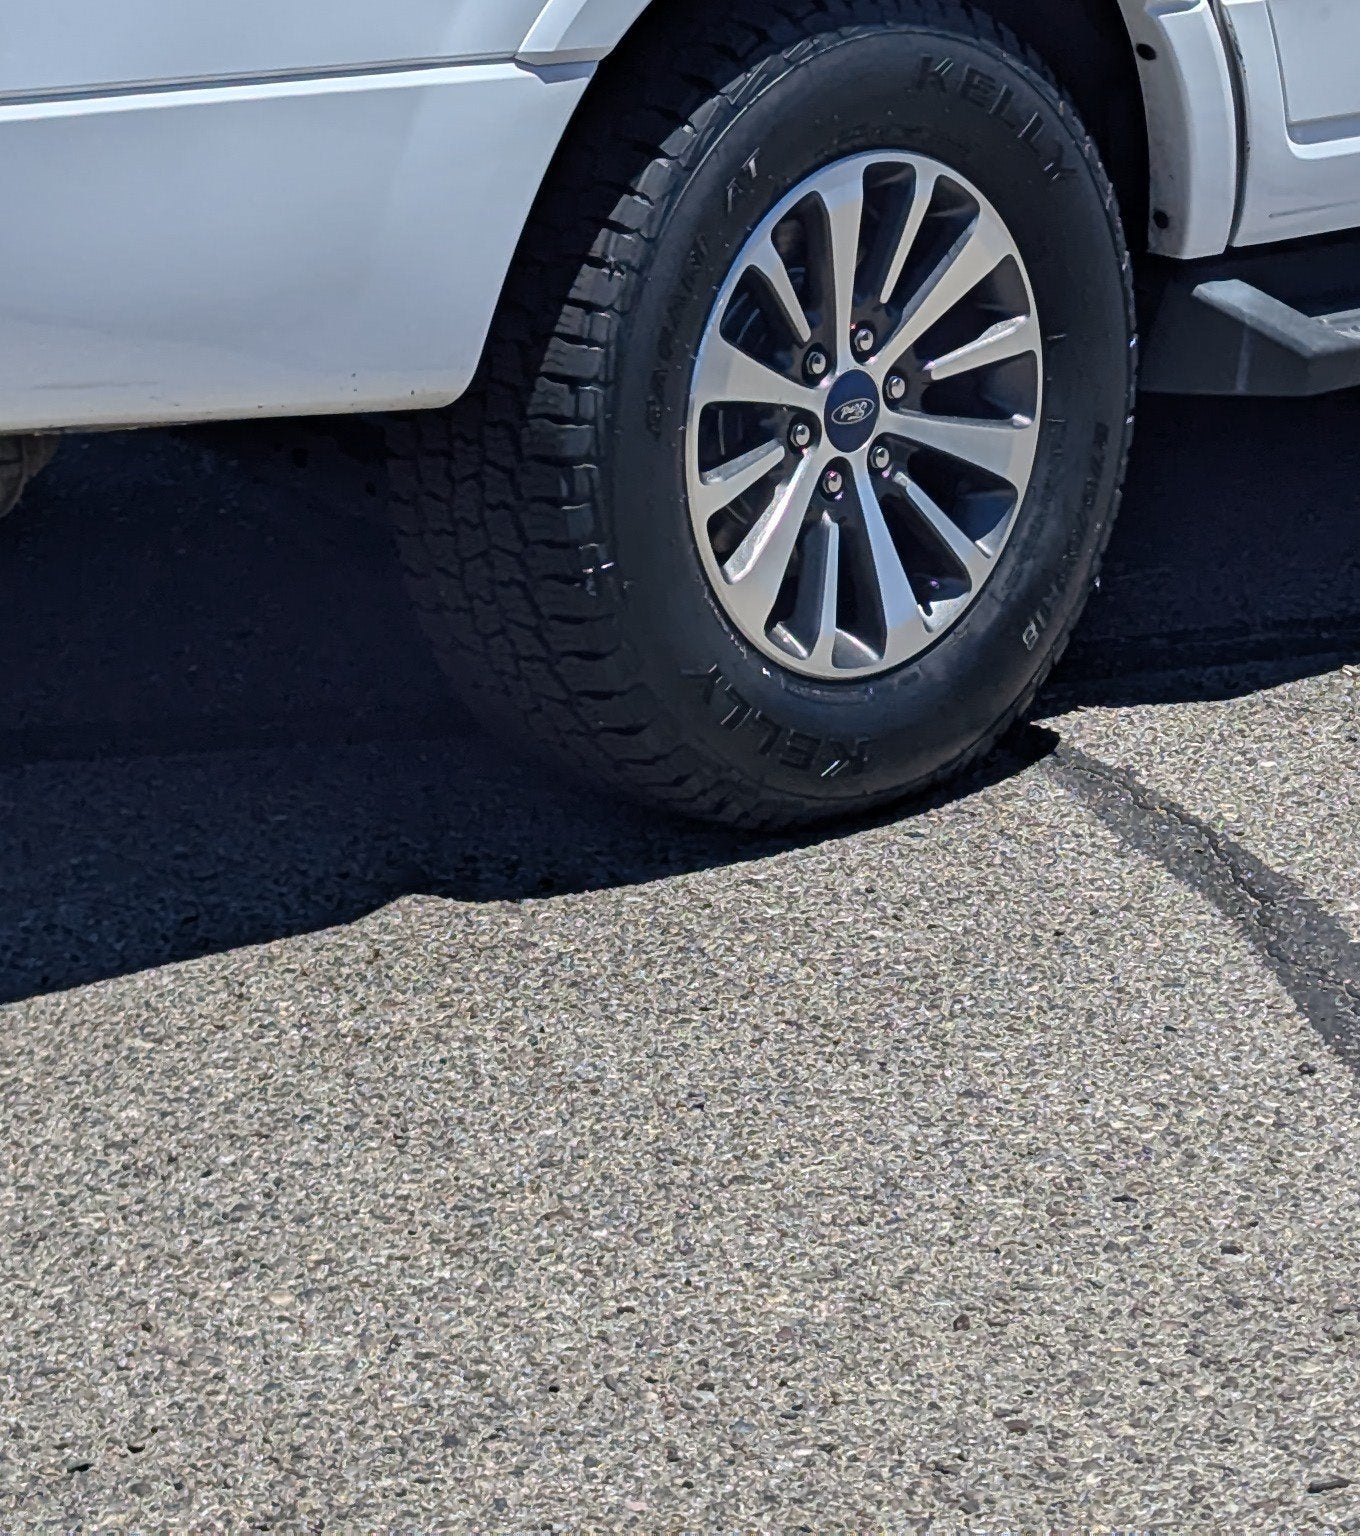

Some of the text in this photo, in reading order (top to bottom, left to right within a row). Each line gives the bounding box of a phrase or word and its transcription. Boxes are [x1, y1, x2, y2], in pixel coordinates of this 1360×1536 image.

[915, 55, 1079, 181] KELLY
[840, 401, 868, 421] Ford
[681, 663, 870, 778] KELLY
